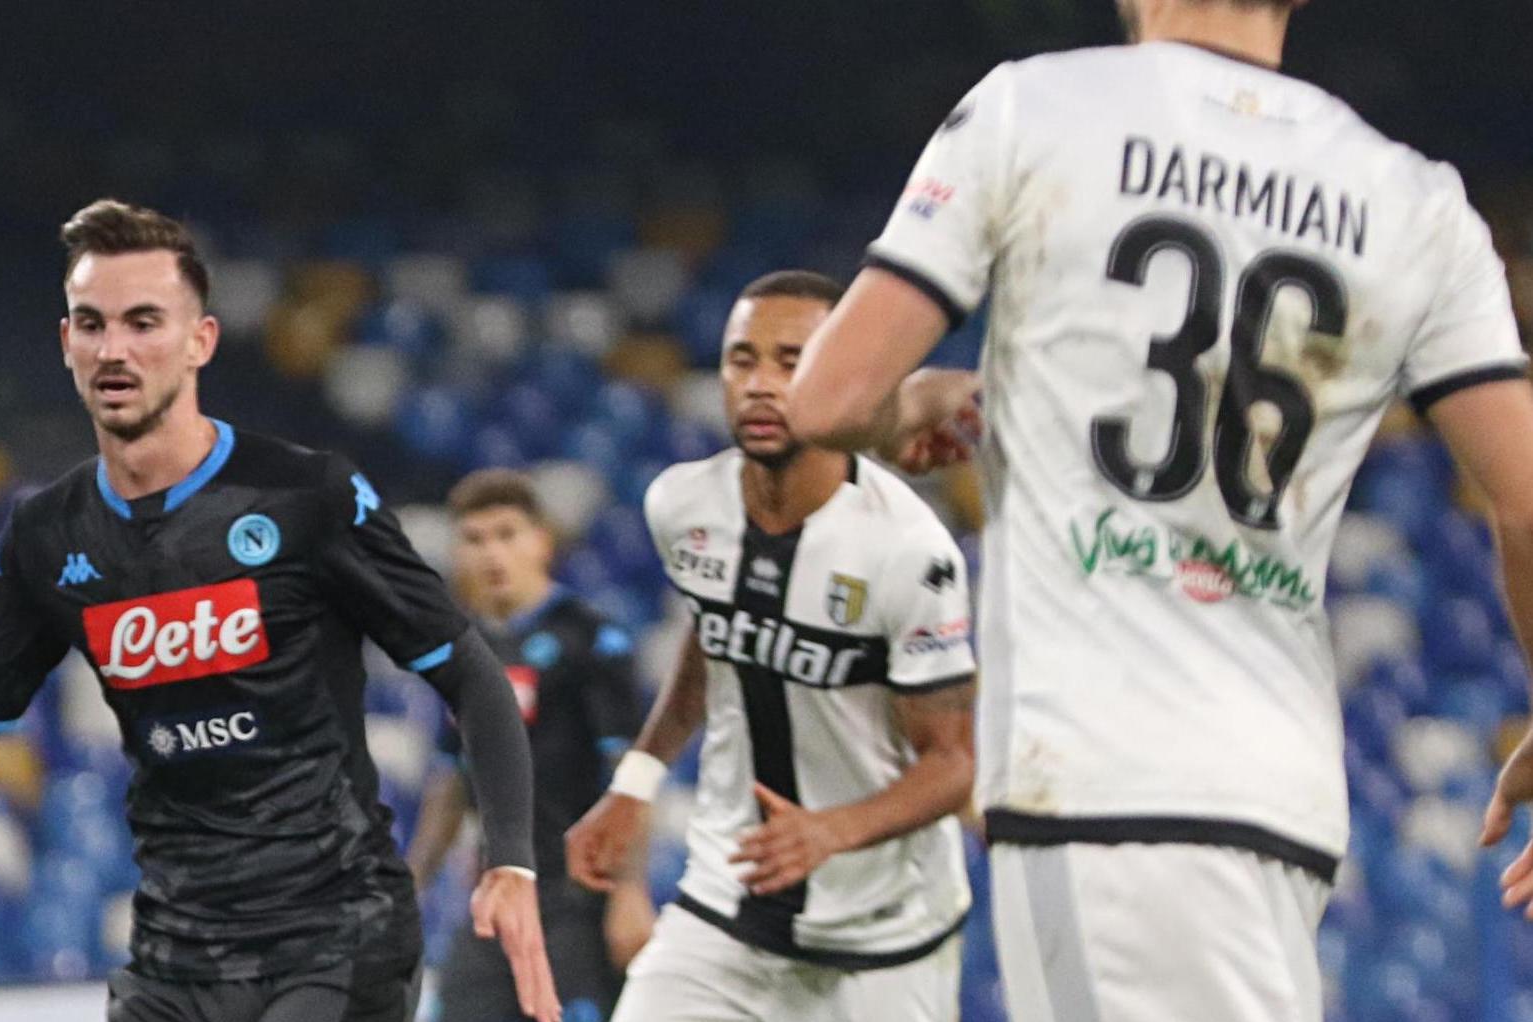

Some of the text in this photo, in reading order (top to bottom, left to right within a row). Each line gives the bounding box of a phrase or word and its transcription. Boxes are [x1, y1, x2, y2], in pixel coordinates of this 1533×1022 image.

[1119, 136, 1369, 258] DARMIAN
[1091, 212, 1349, 531] 36
[99, 599, 261, 680] Lete
[175, 711, 259, 753] MSC
